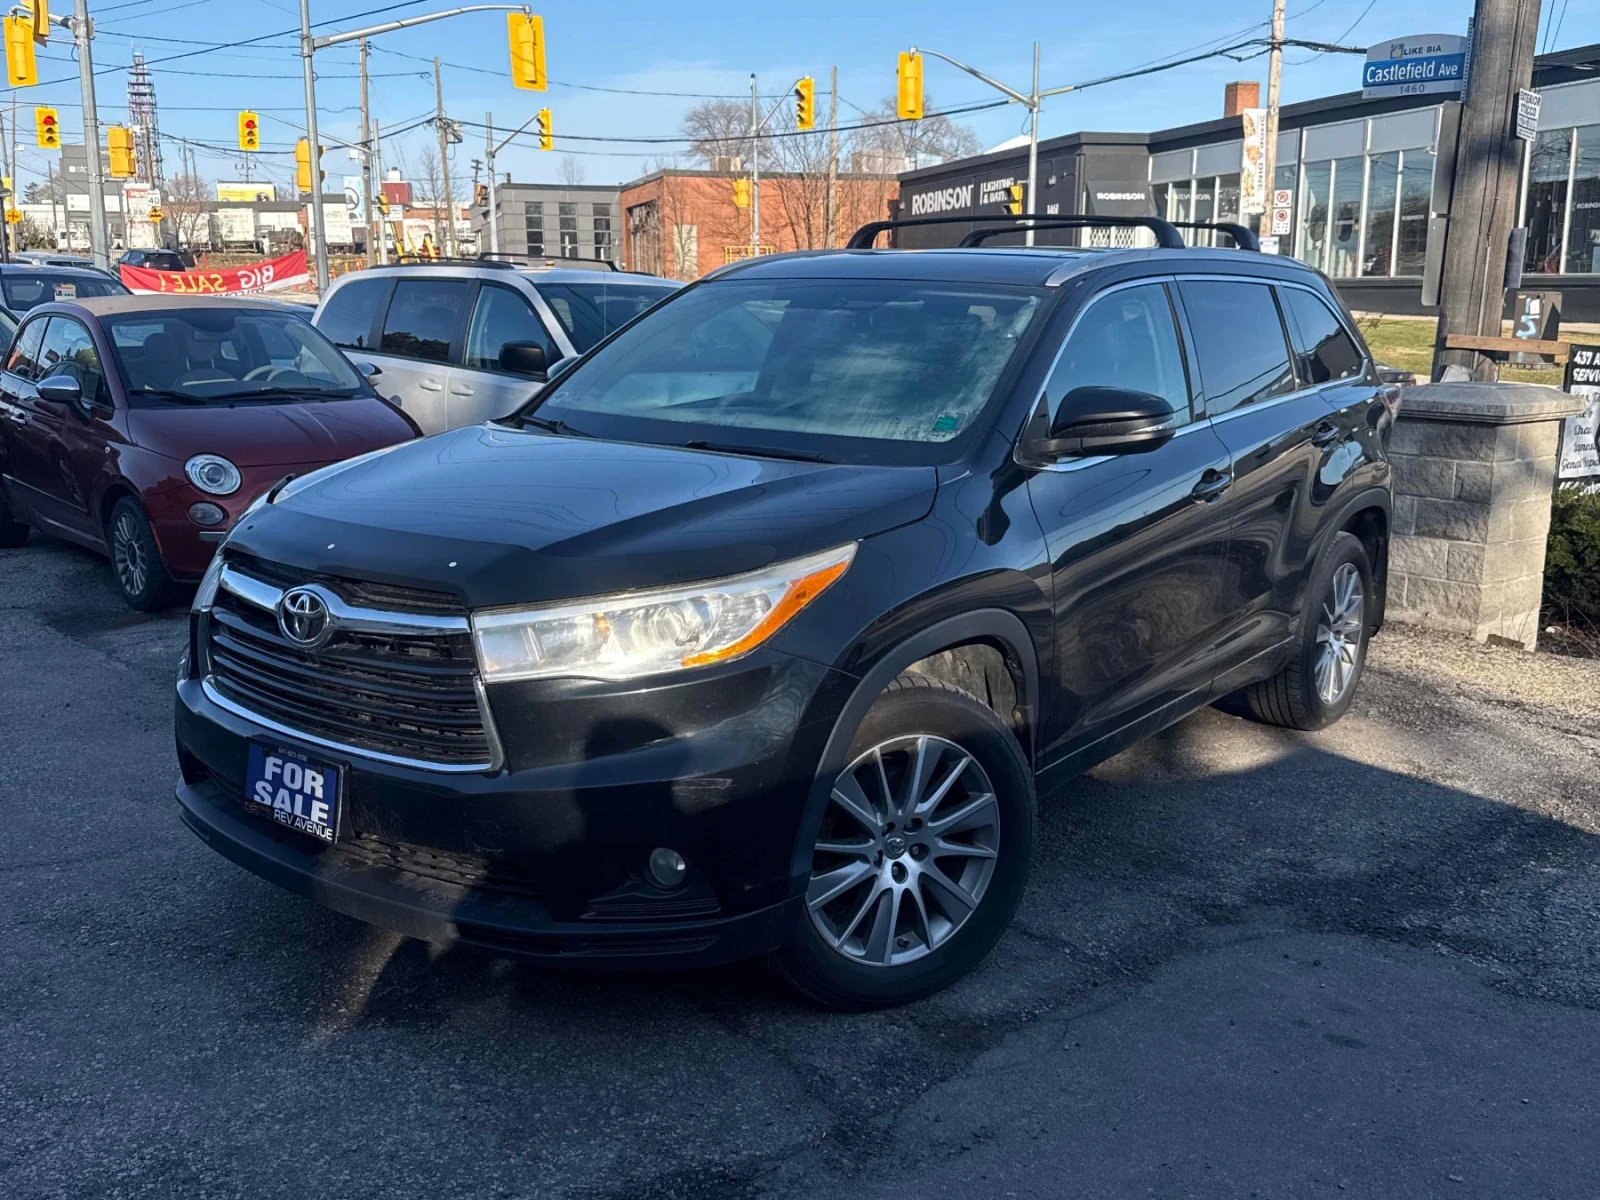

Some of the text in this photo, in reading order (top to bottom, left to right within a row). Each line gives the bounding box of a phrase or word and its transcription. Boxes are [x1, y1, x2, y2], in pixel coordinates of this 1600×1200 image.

[1403, 45, 1442, 56] LIKE BIA
[1366, 61, 1458, 83] Castlefield Ave
[1400, 84, 1425, 94] 1460
[983, 177, 1014, 193] LIGHTING
[149, 197, 160, 205] 40
[911, 184, 974, 216] ROBINSON
[1096, 192, 1146, 200] ROBINSON
[1573, 351, 1593, 365] 437
[1573, 368, 1600, 382] SERVI
[264, 756, 325, 799] FOR
[253, 780, 329, 827] SALE
[273, 809, 333, 841] REV AVENUE
